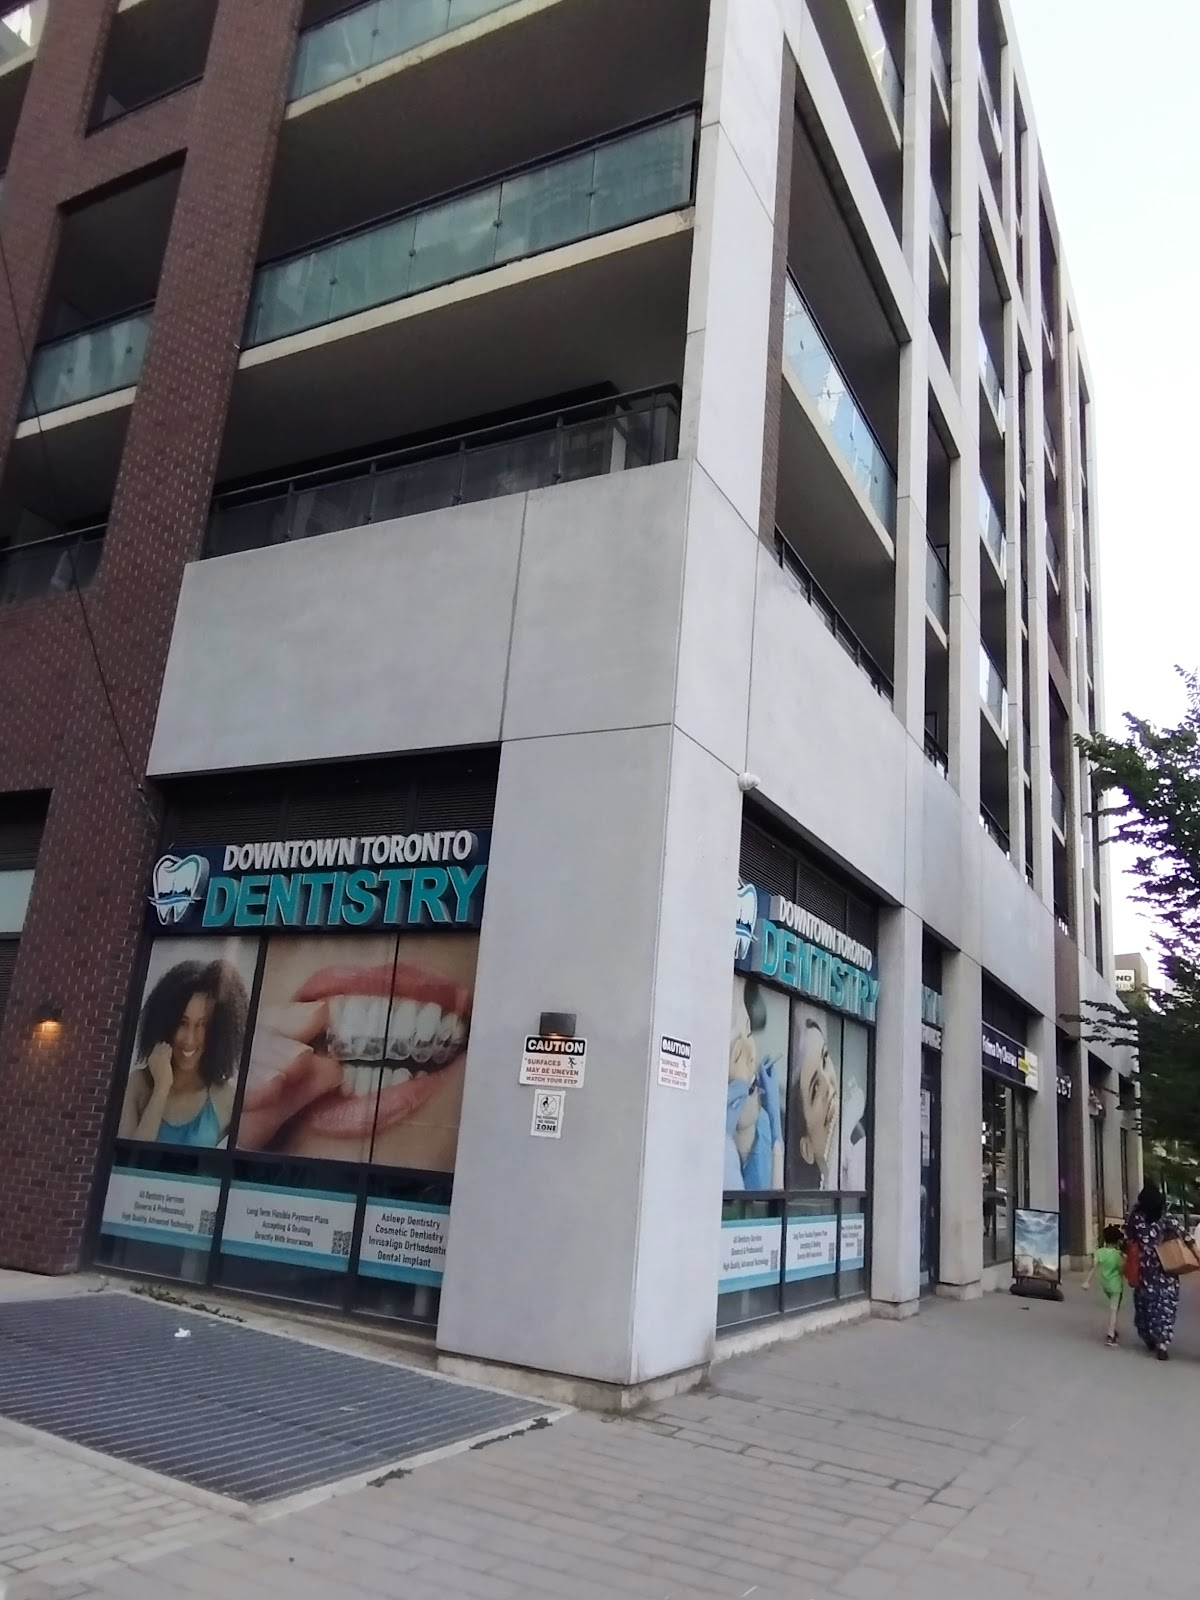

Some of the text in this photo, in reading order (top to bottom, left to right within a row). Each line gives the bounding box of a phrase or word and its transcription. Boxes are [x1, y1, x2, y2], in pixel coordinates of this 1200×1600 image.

[223, 830, 475, 871] DOWNTOWN TORONTO
[202, 864, 487, 928] DENTISTRY
[779, 894, 873, 972] DOWNTOWN TORONTO
[761, 917, 880, 1023] DENTISTRY
[528, 1039, 584, 1054] CAUTION
[662, 1038, 690, 1058] CAUTION
[527, 1058, 561, 1067] SURFACES
[541, 1067, 550, 1075] BE
[551, 1068, 579, 1076] UNEVEN
[536, 1123, 557, 1132] ZONE
[246, 1207, 329, 1225] Long Term Flexible Payment Plans
[382, 1213, 440, 1231] Asleep Dentistry
[262, 1220, 286, 1232] Accepting
[287, 1223, 291, 1232] &
[375, 1223, 443, 1243] Cosmetic Dentistry
[255, 1231, 273, 1243] Directly
[274, 1234, 285, 1243] With
[368, 1235, 403, 1250] Invisalign
[378, 1250, 401, 1263] Dental
